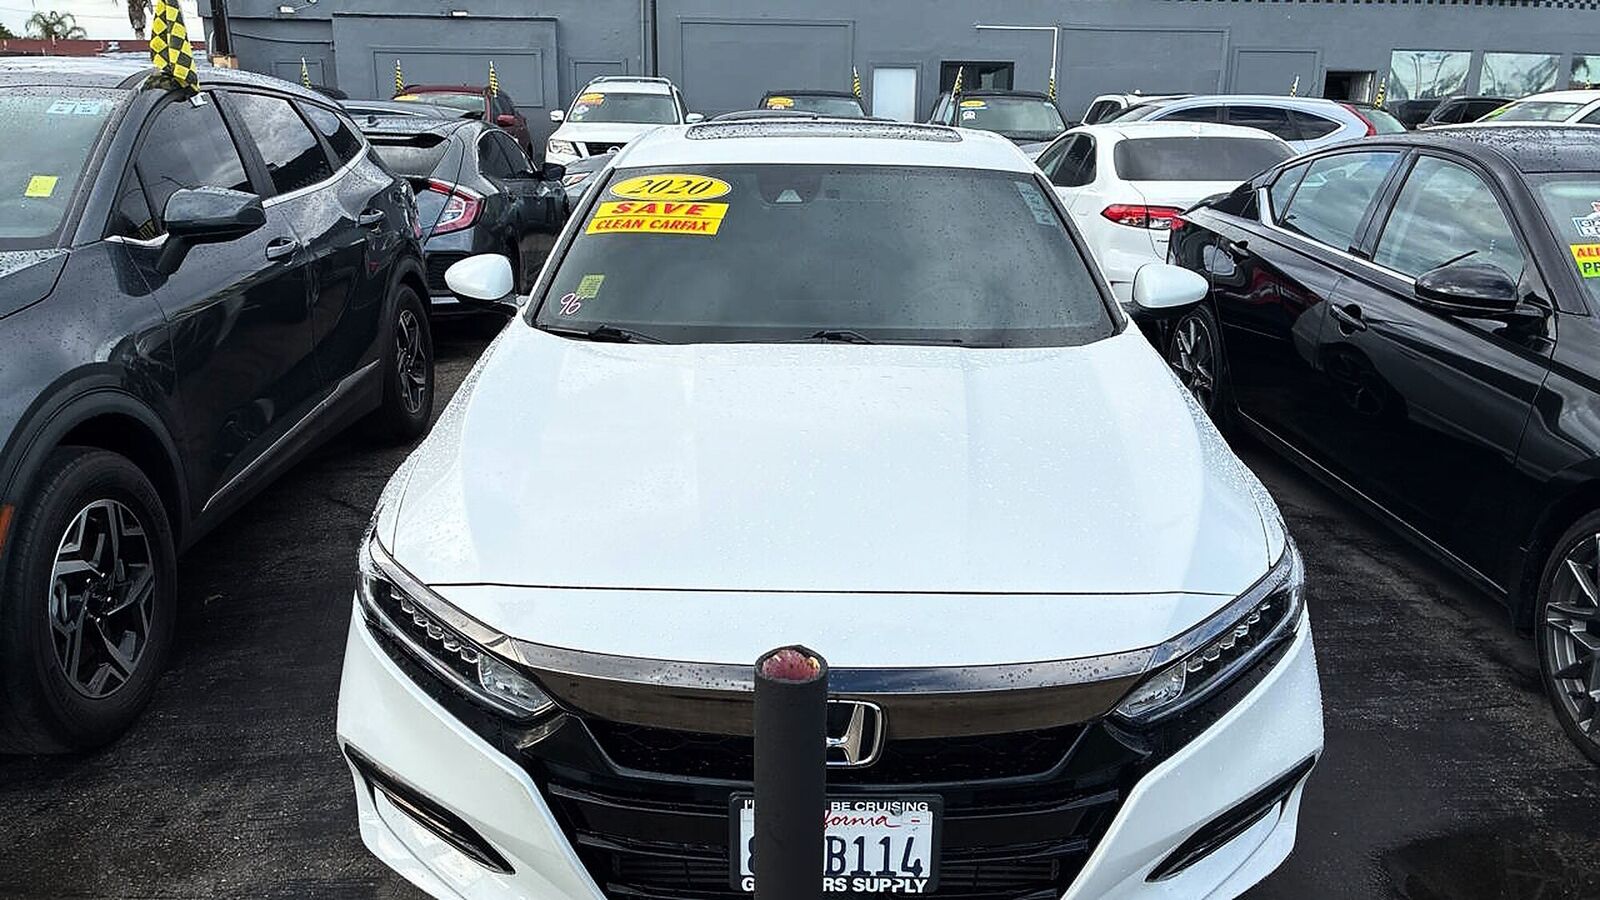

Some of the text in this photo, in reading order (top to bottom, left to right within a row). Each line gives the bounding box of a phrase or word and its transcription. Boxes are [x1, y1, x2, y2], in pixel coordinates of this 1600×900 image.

[627, 179, 714, 195] 2020
[612, 202, 709, 216] SAVE
[595, 218, 711, 231] CLEAN CARFAX
[559, 292, 581, 315] 96
[831, 801, 850, 811] BE
[854, 801, 929, 812] CRUISING
[852, 877, 928, 893] SUPPLY
